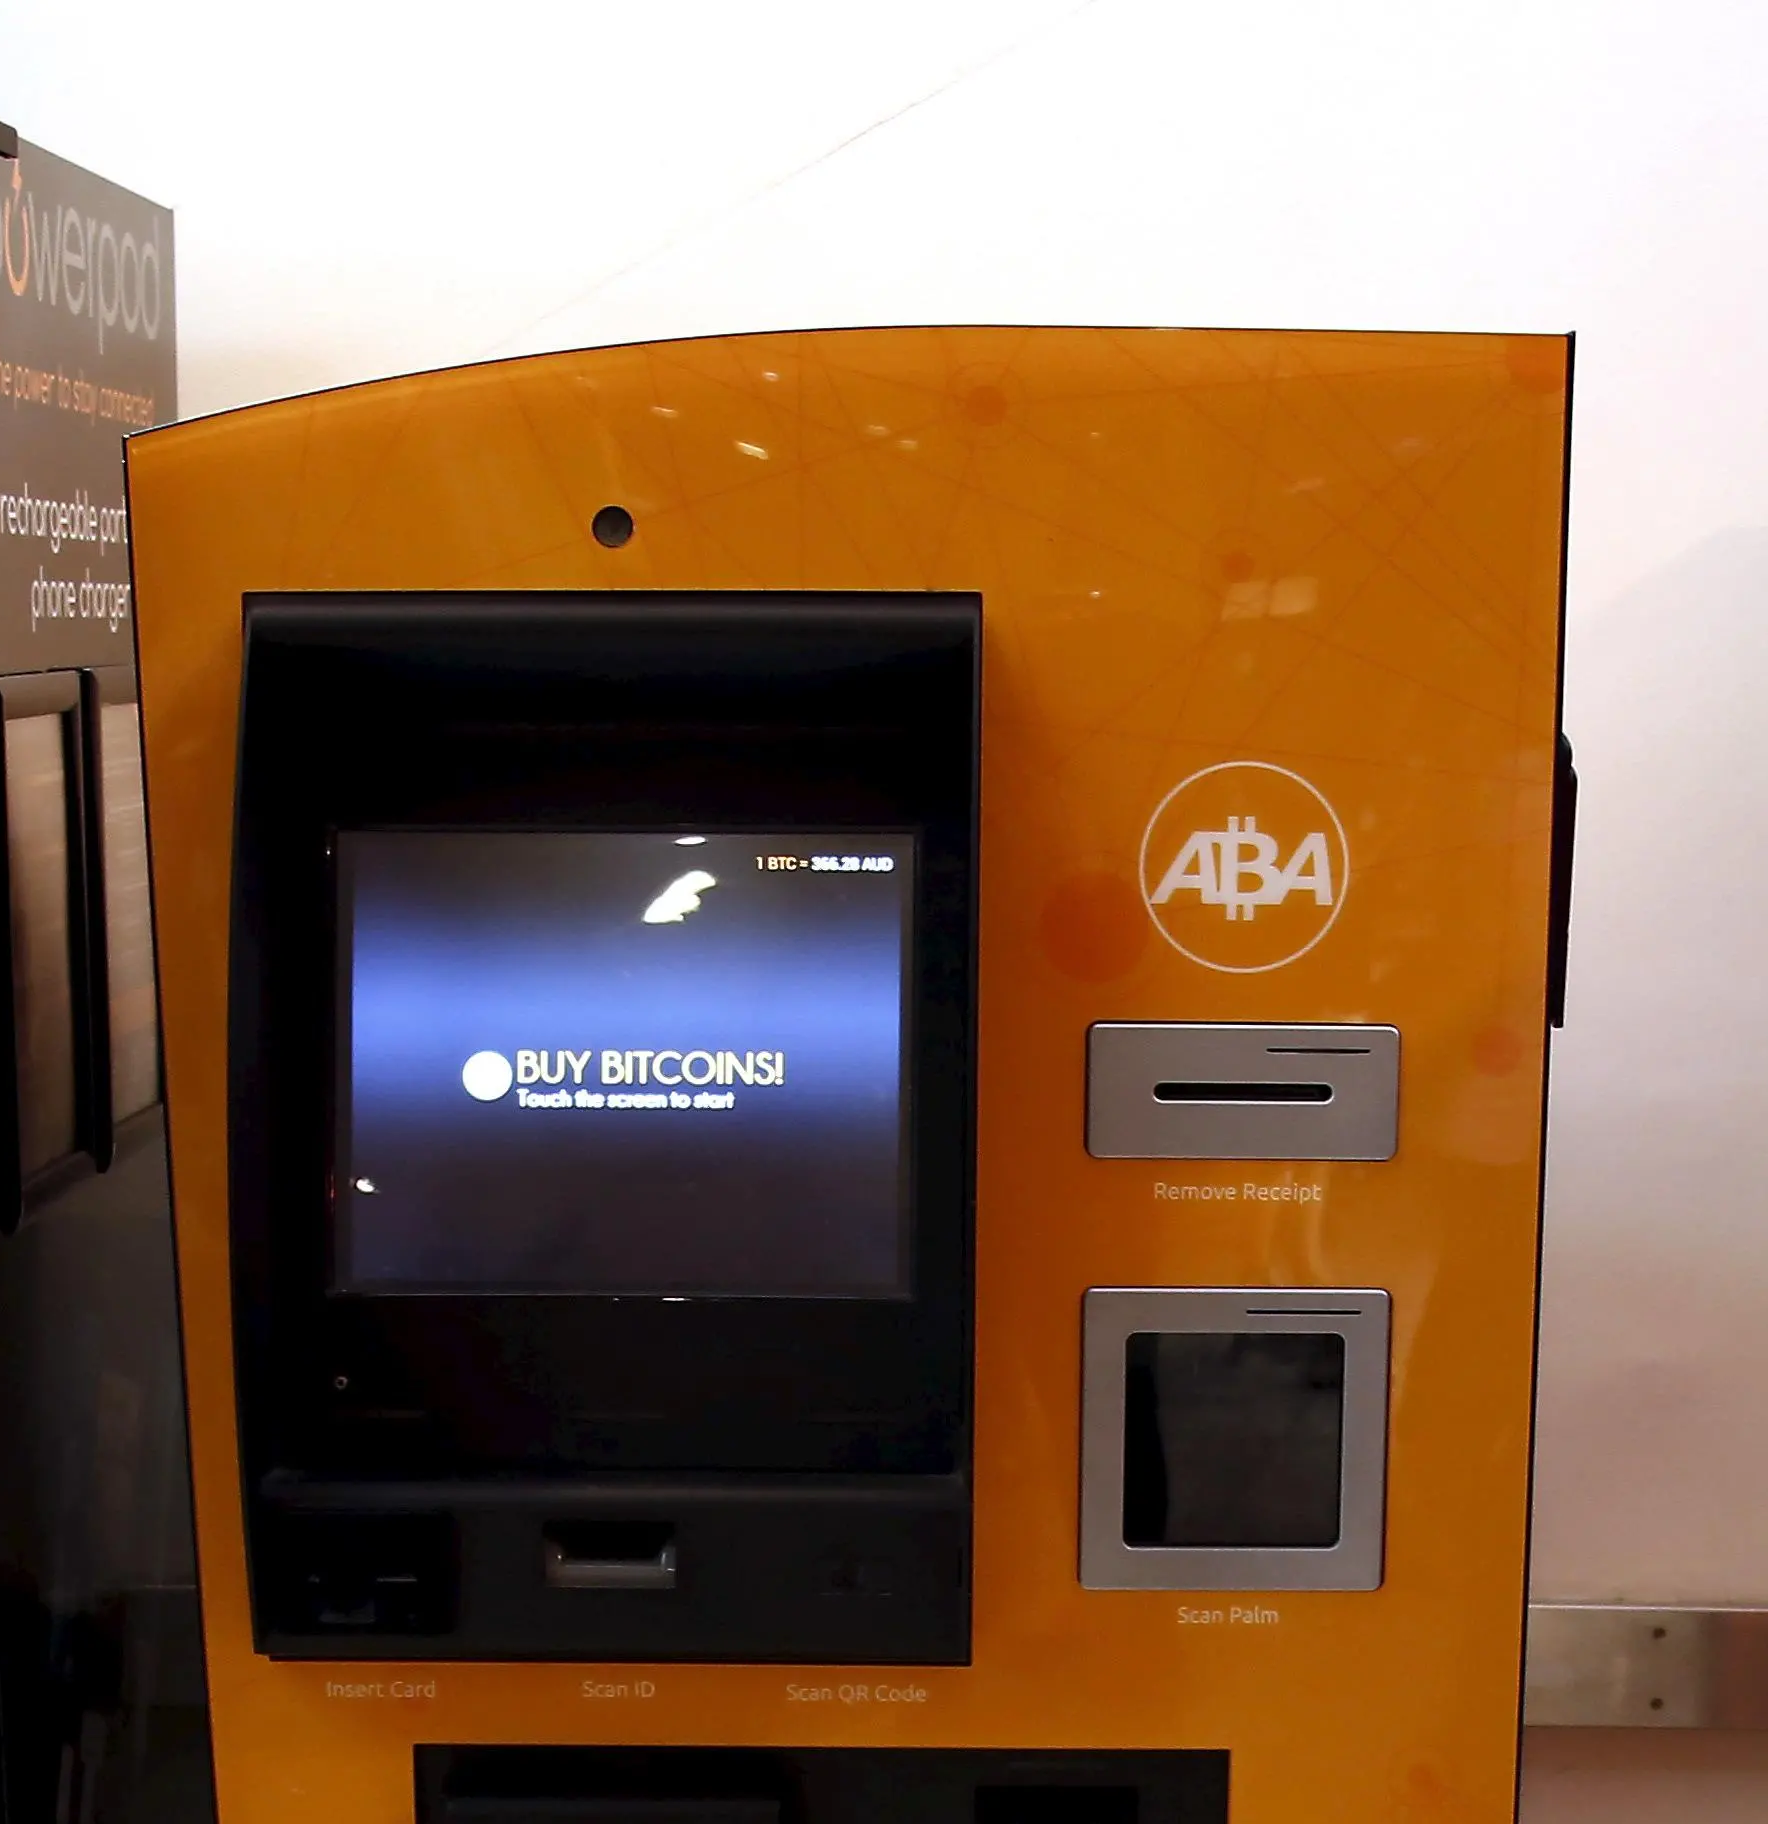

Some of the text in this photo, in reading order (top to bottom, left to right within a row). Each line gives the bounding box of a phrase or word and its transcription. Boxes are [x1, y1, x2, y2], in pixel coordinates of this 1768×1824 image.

[13, 365, 55, 412] power
[0, 482, 128, 557] rechargeable port
[32, 565, 131, 633] phone charger
[756, 856, 763, 870] 1
[767, 856, 797, 870] BTC
[861, 856, 894, 871] AUD
[516, 1050, 785, 1086] BUY BITCOINS!
[516, 1088, 735, 1109] Touch the screen to start
[1154, 1182, 1322, 1206] Remove Receipt
[1177, 1606, 1279, 1624] Scan Palm
[326, 1681, 437, 1698] Insert Card
[582, 1681, 656, 1698] Scan ID
[786, 1684, 927, 1705] Scan QR Code
